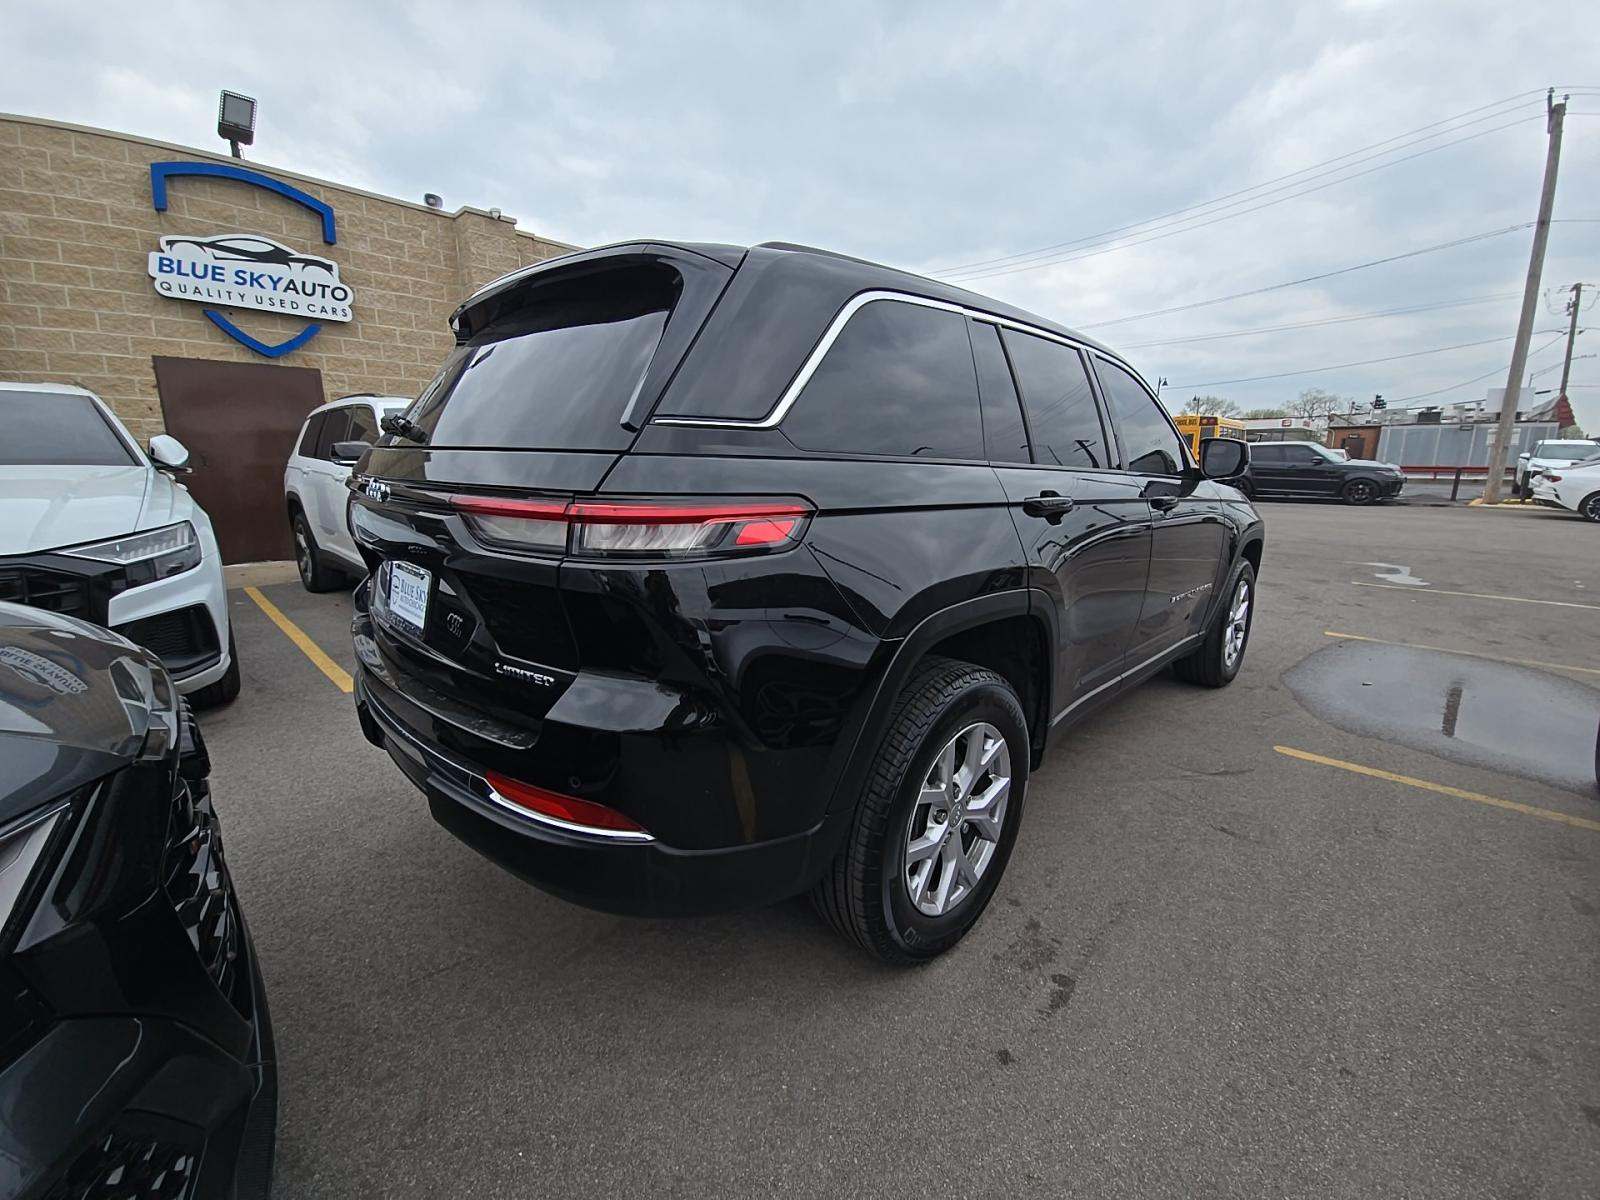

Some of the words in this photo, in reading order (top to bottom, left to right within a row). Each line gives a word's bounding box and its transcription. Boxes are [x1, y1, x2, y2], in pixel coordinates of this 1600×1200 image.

[158, 256, 225, 283] BLUE
[160, 281, 246, 303] QUALITY
[254, 294, 299, 310] USED
[306, 303, 348, 318] CARS
